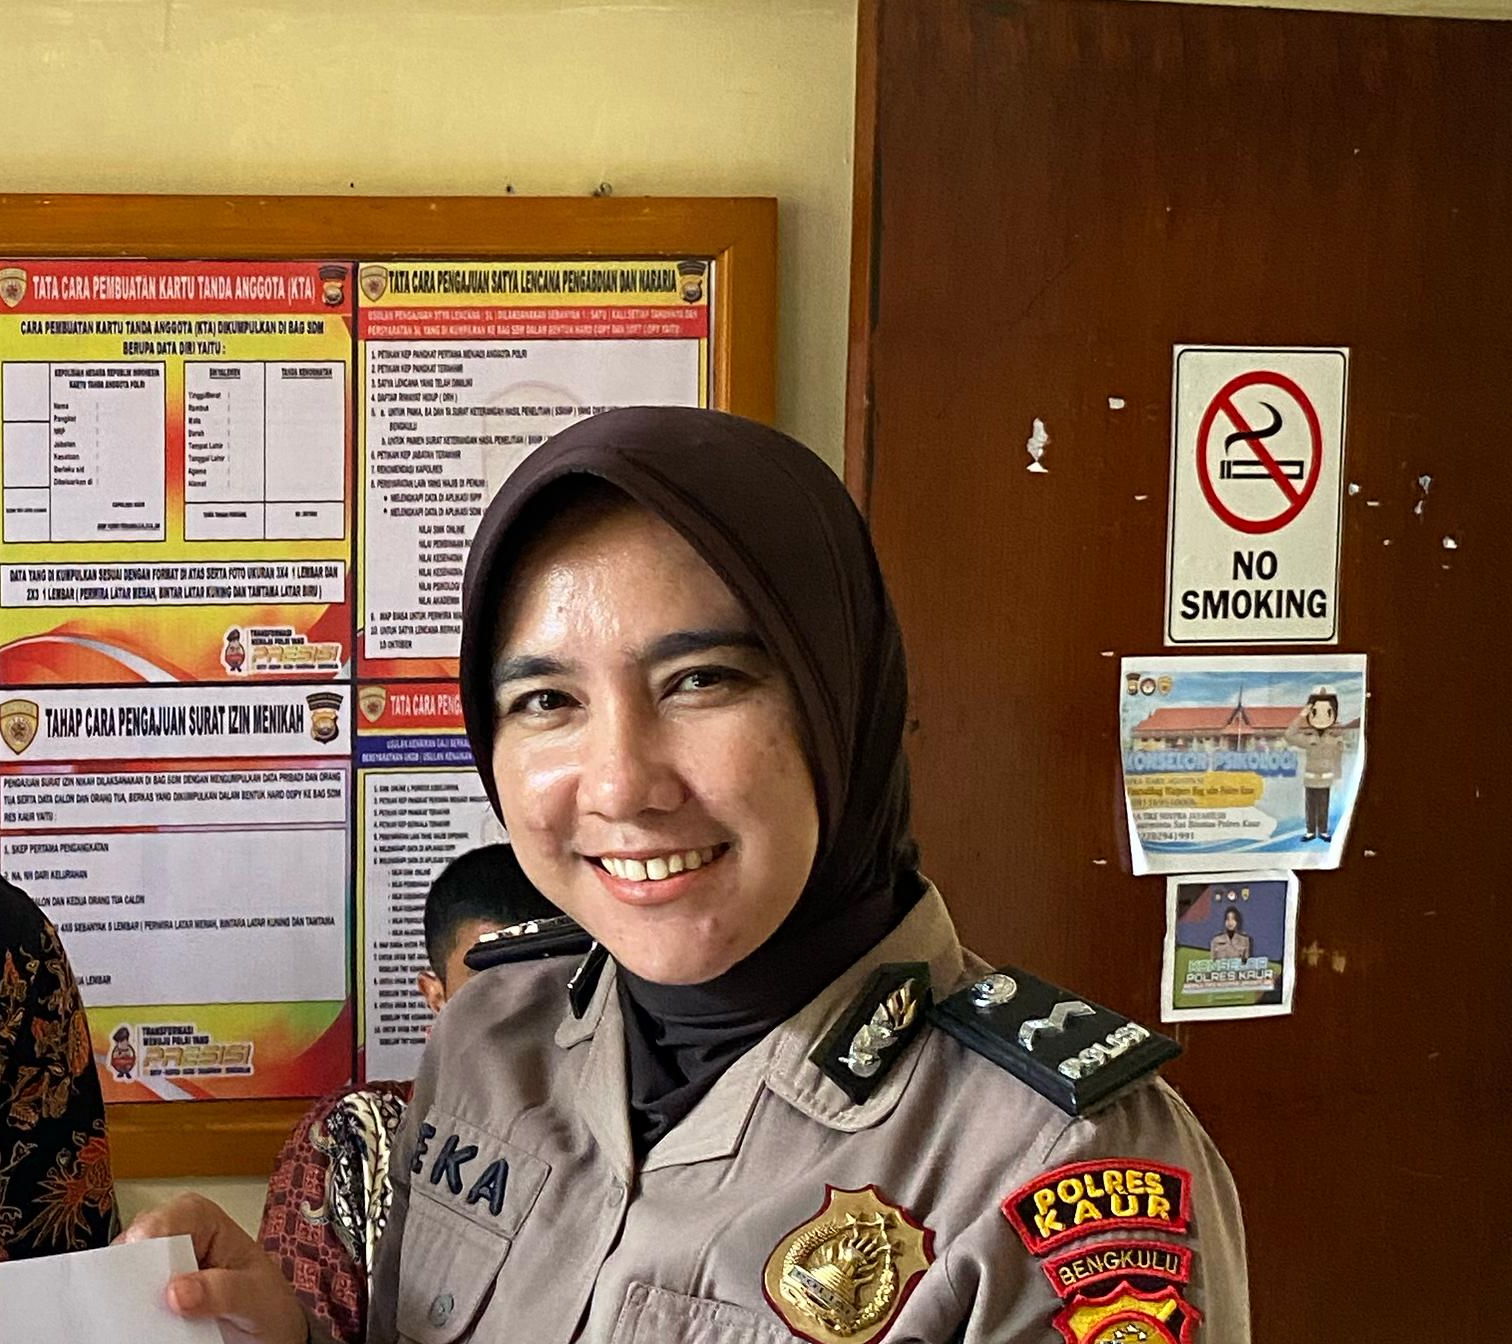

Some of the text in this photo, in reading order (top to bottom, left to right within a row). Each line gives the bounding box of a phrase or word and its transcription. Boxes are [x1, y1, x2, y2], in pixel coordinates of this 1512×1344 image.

[33, 275, 316, 305] TATA CARA PEMBUATAN KARTU TANDA ANGGOTA (KTA)
[388, 270, 410, 293] TATA
[412, 270, 435, 293] CARA
[438, 270, 488, 293] PENGAJUAN
[491, 270, 518, 293] SATYA
[21, 322, 43, 335] CARA
[45, 321, 93, 335] PEMBUATAN
[96, 321, 123, 334] KARTU
[126, 322, 151, 334] TANDA
[154, 322, 192, 334] ANGGOTA
[156, 342, 177, 355] DATA
[1232, 550, 1278, 580] NO
[1181, 589, 1327, 619] SMOKING
[46, 704, 303, 738] TAHAP CARA PENGAJUAN SURAT IZIN MENIKAH
[1187, 969, 1272, 982] POLRES KAUR
[408, 1121, 510, 1217] EKA
[1034, 1169, 1164, 1215] POLRES
[1034, 1194, 1170, 1237] KAUR
[1060, 1250, 1178, 1285] BENGKULU
